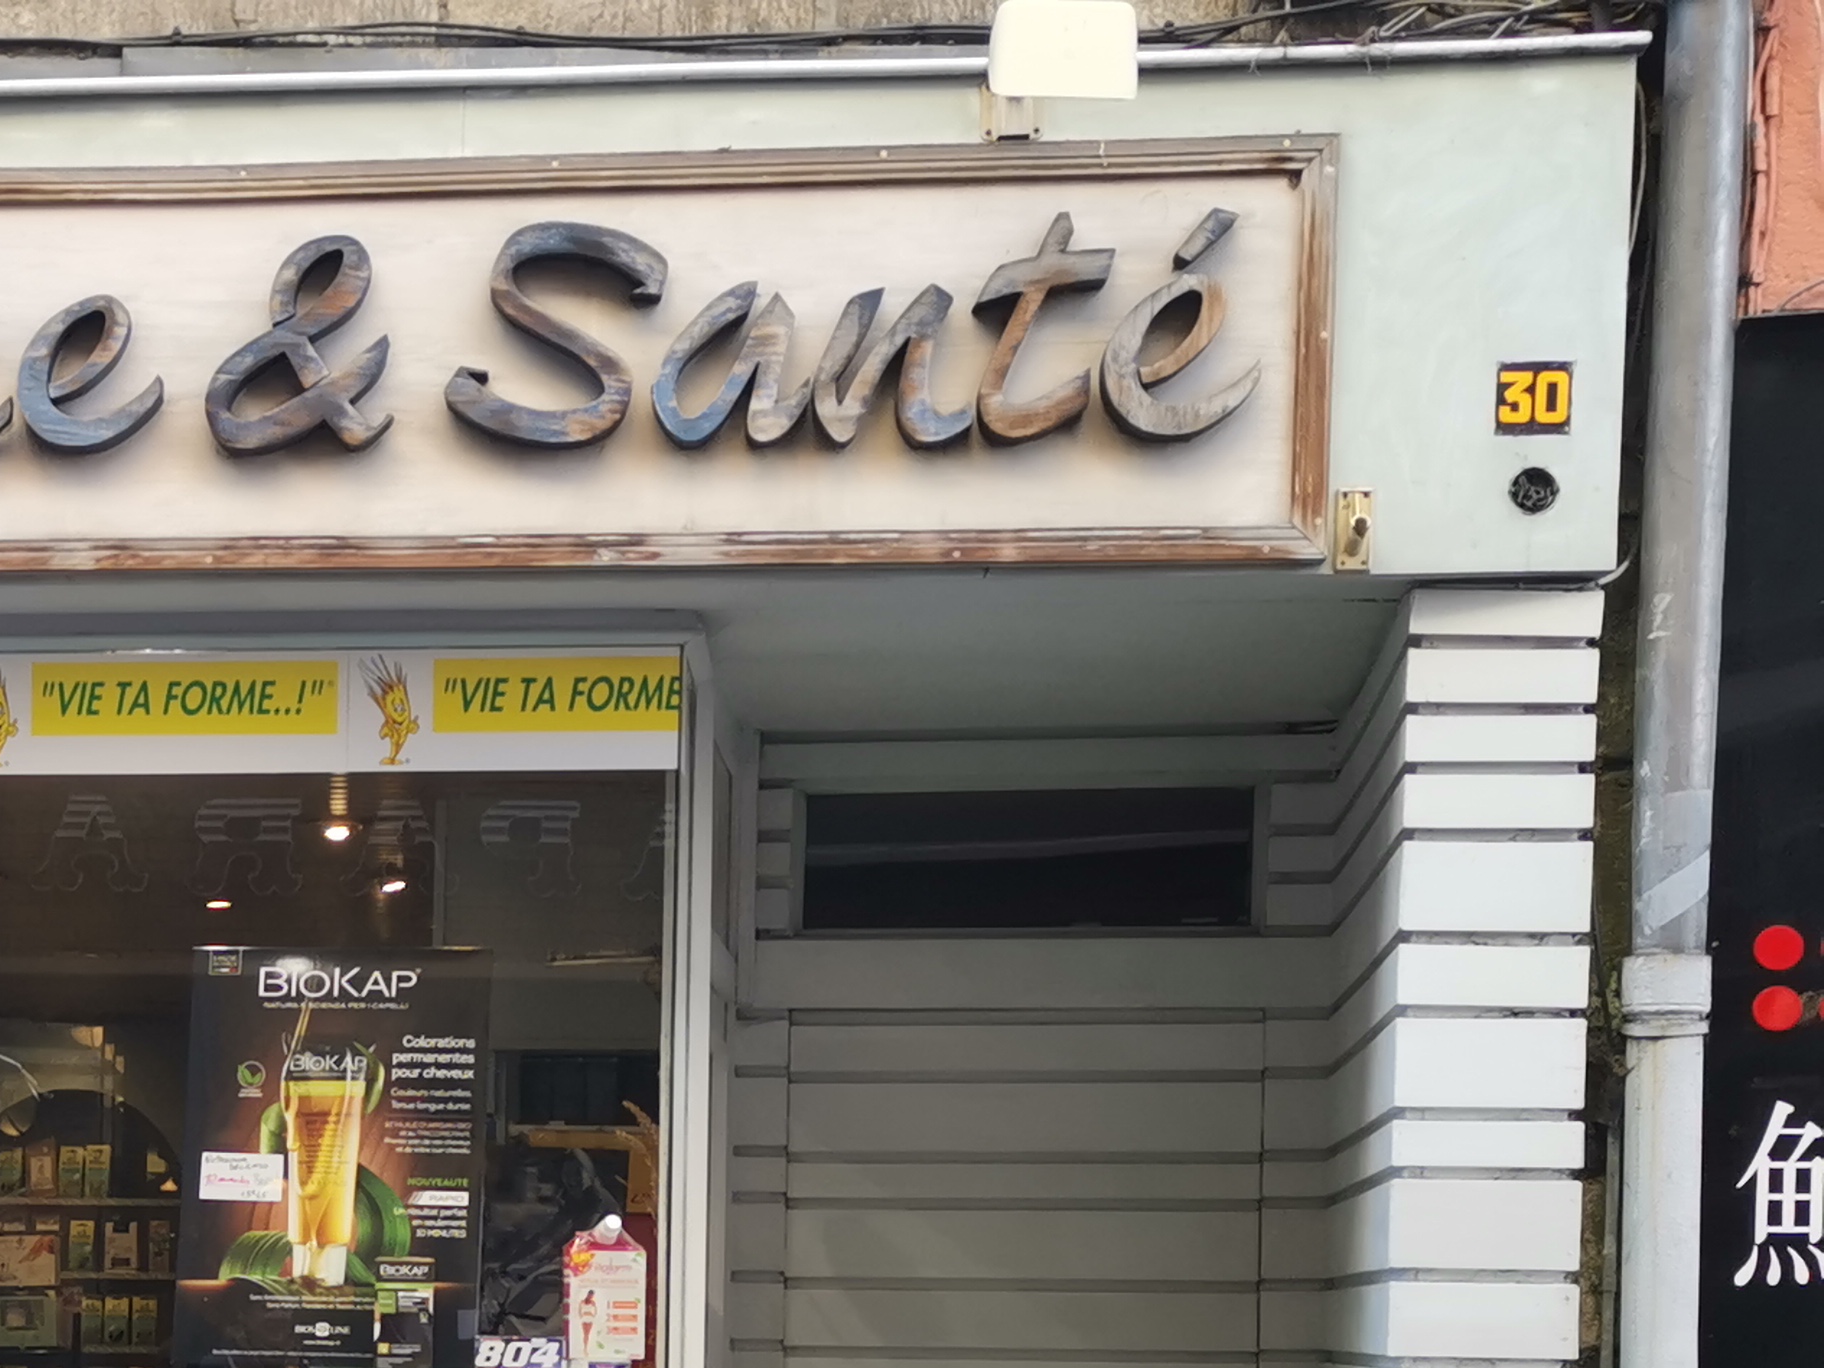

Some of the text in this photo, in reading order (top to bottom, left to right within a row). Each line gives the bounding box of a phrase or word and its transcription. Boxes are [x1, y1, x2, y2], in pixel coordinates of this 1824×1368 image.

[206, 234, 393, 457] &
[444, 208, 1262, 450] Santé
[1498, 370, 1570, 424] 30
[115, 681, 152, 717] TA
[519, 677, 557, 713] TA
[258, 966, 419, 998] BIOKAP
[402, 1034, 476, 1049] Colorations
[391, 1067, 475, 1081] pour cheveux
[392, 1052, 475, 1066] permanentes
